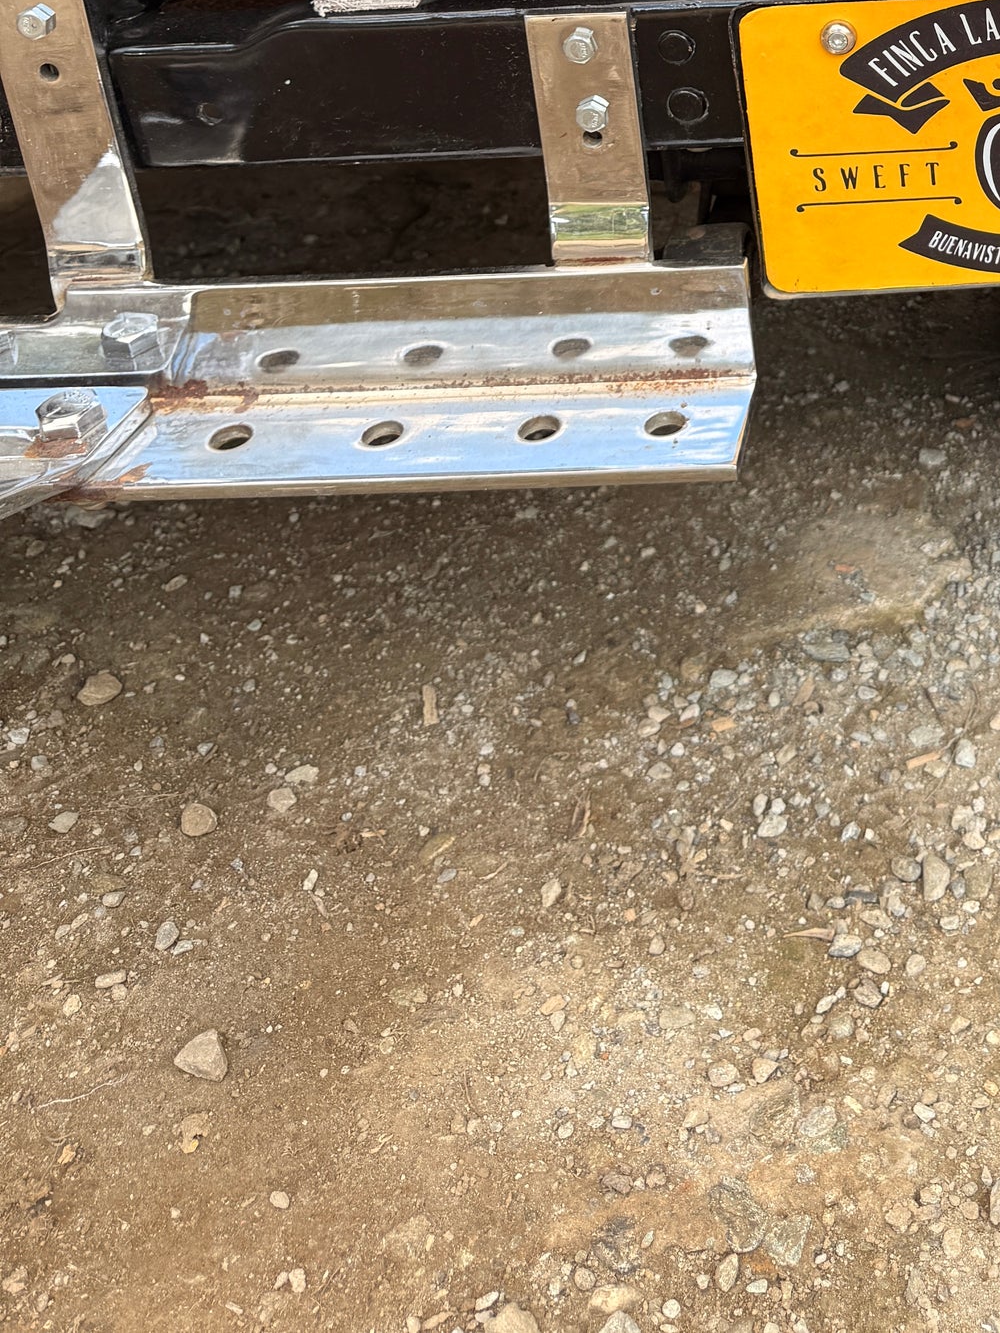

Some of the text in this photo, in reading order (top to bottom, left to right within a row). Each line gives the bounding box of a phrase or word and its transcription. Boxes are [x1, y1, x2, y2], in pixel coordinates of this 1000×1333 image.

[867, 22, 957, 87] FINCA
[959, 7, 1000, 45] LA
[812, 162, 940, 192] SWEFT
